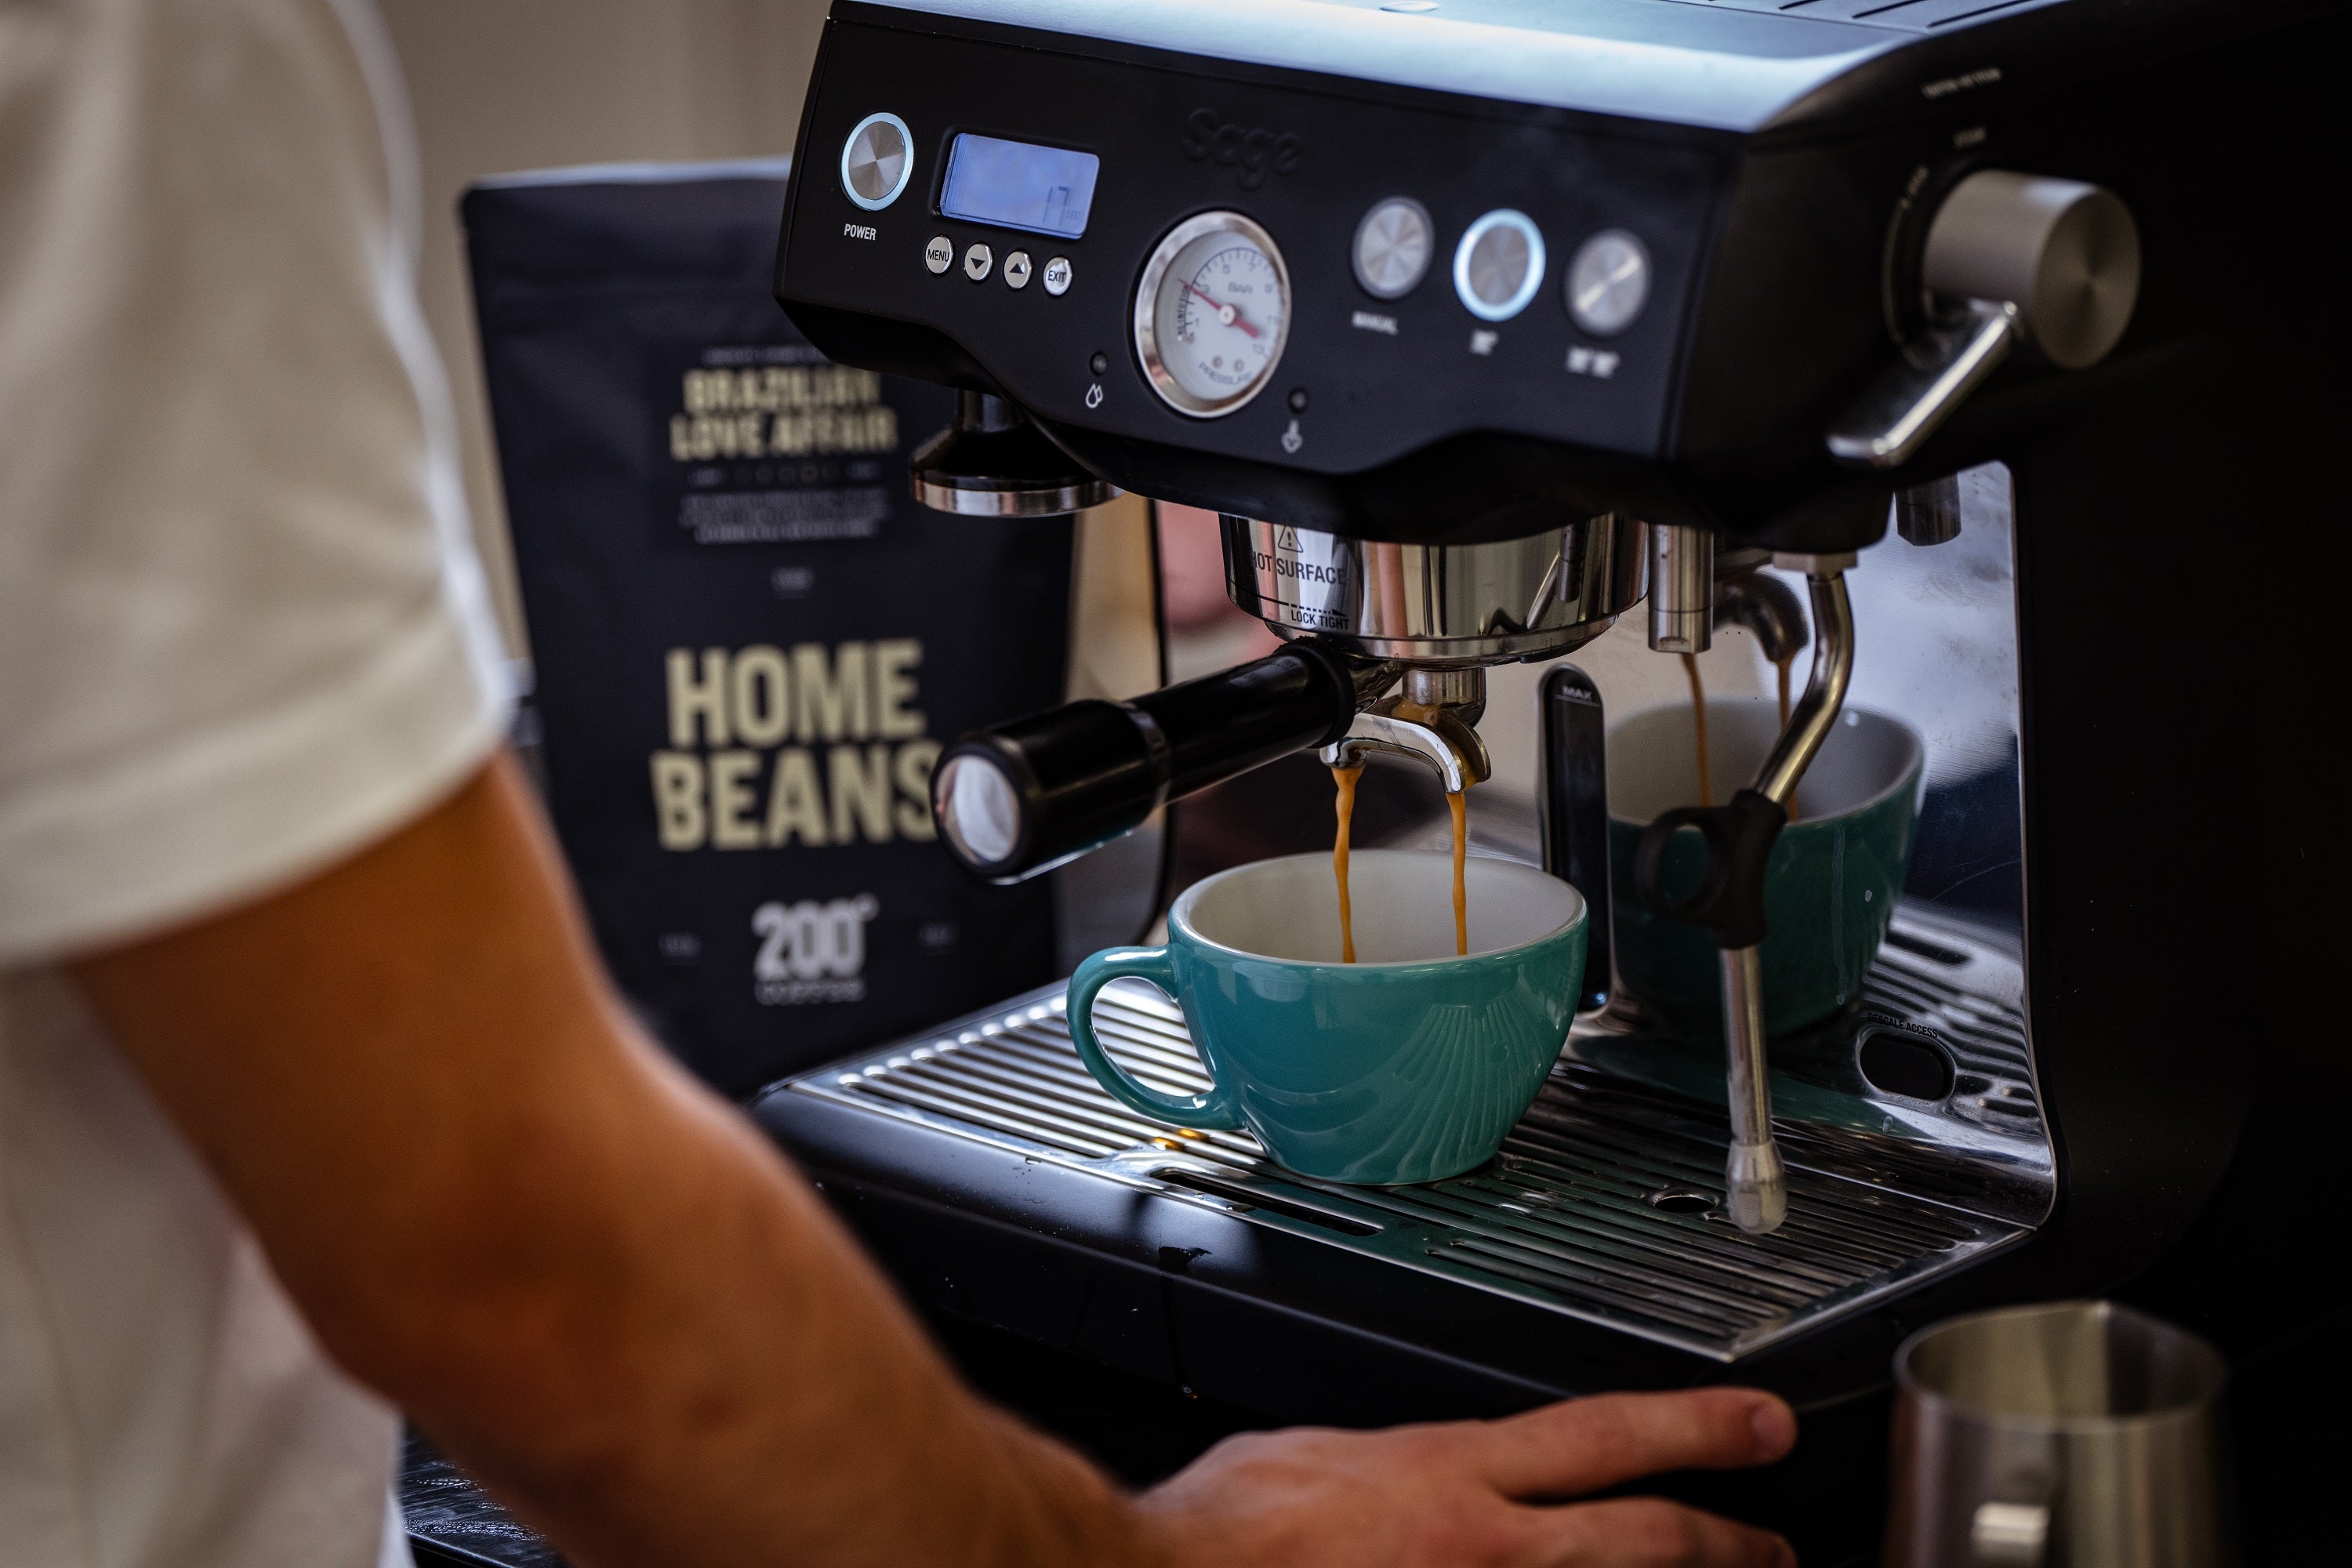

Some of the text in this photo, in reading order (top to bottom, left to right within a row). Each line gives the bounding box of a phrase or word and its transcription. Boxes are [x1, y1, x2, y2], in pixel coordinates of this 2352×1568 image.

[1180, 108, 1299, 192] Sage
[1042, 186, 1070, 227] 17
[844, 223, 877, 241] POWER
[927, 248, 950, 262] MENU
[1047, 270, 1067, 283] EXIT
[1228, 281, 1254, 295] BAR
[670, 412, 766, 461] LOVE
[1276, 557, 1348, 585] SURFACE
[1291, 609, 1350, 630] LOCK TIGHT
[665, 637, 927, 748] HOME
[1562, 684, 1593, 702] MAX
[649, 737, 944, 852] BEANS
[1867, 1011, 1939, 1039] DESCALE ACCESS
